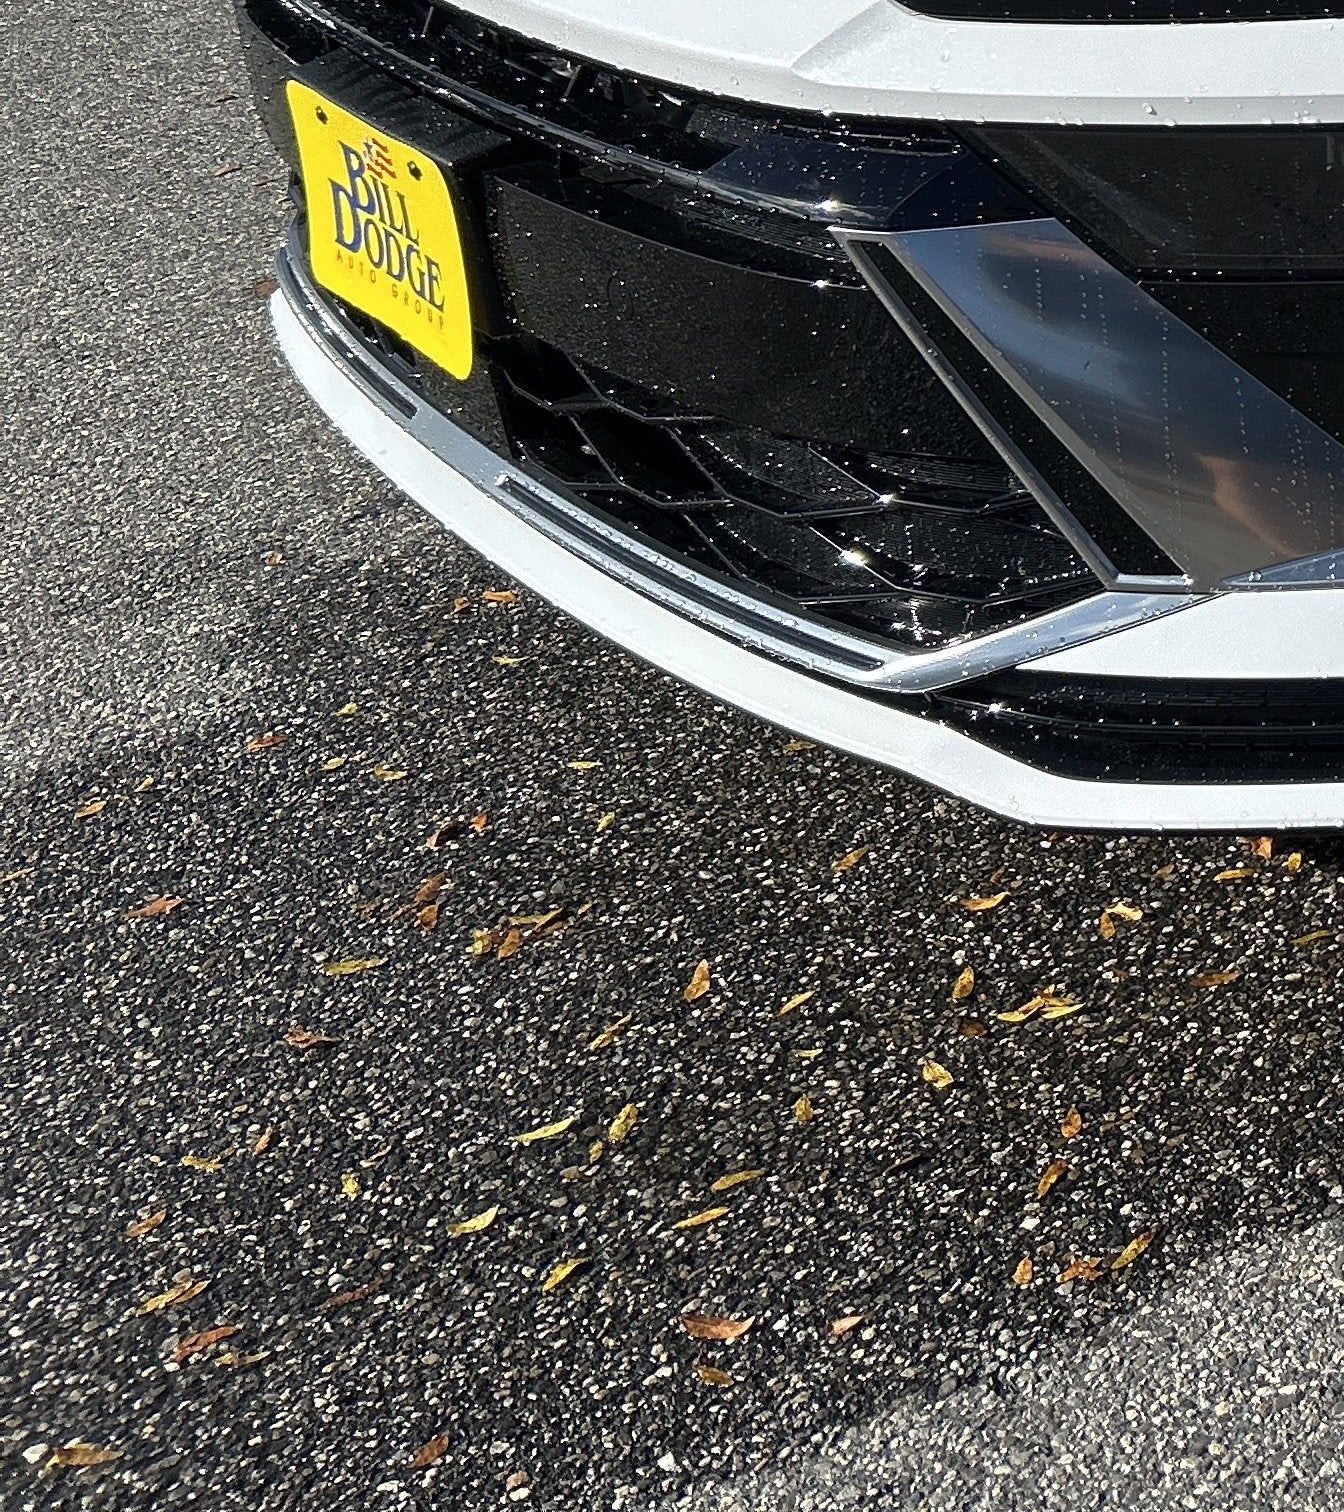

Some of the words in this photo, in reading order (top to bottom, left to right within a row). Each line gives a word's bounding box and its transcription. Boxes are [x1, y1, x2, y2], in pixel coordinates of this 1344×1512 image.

[328, 177, 444, 312] DODGE
[338, 139, 420, 247] BILL
[335, 248, 377, 285] AUTO
[391, 282, 445, 331] GROUP
